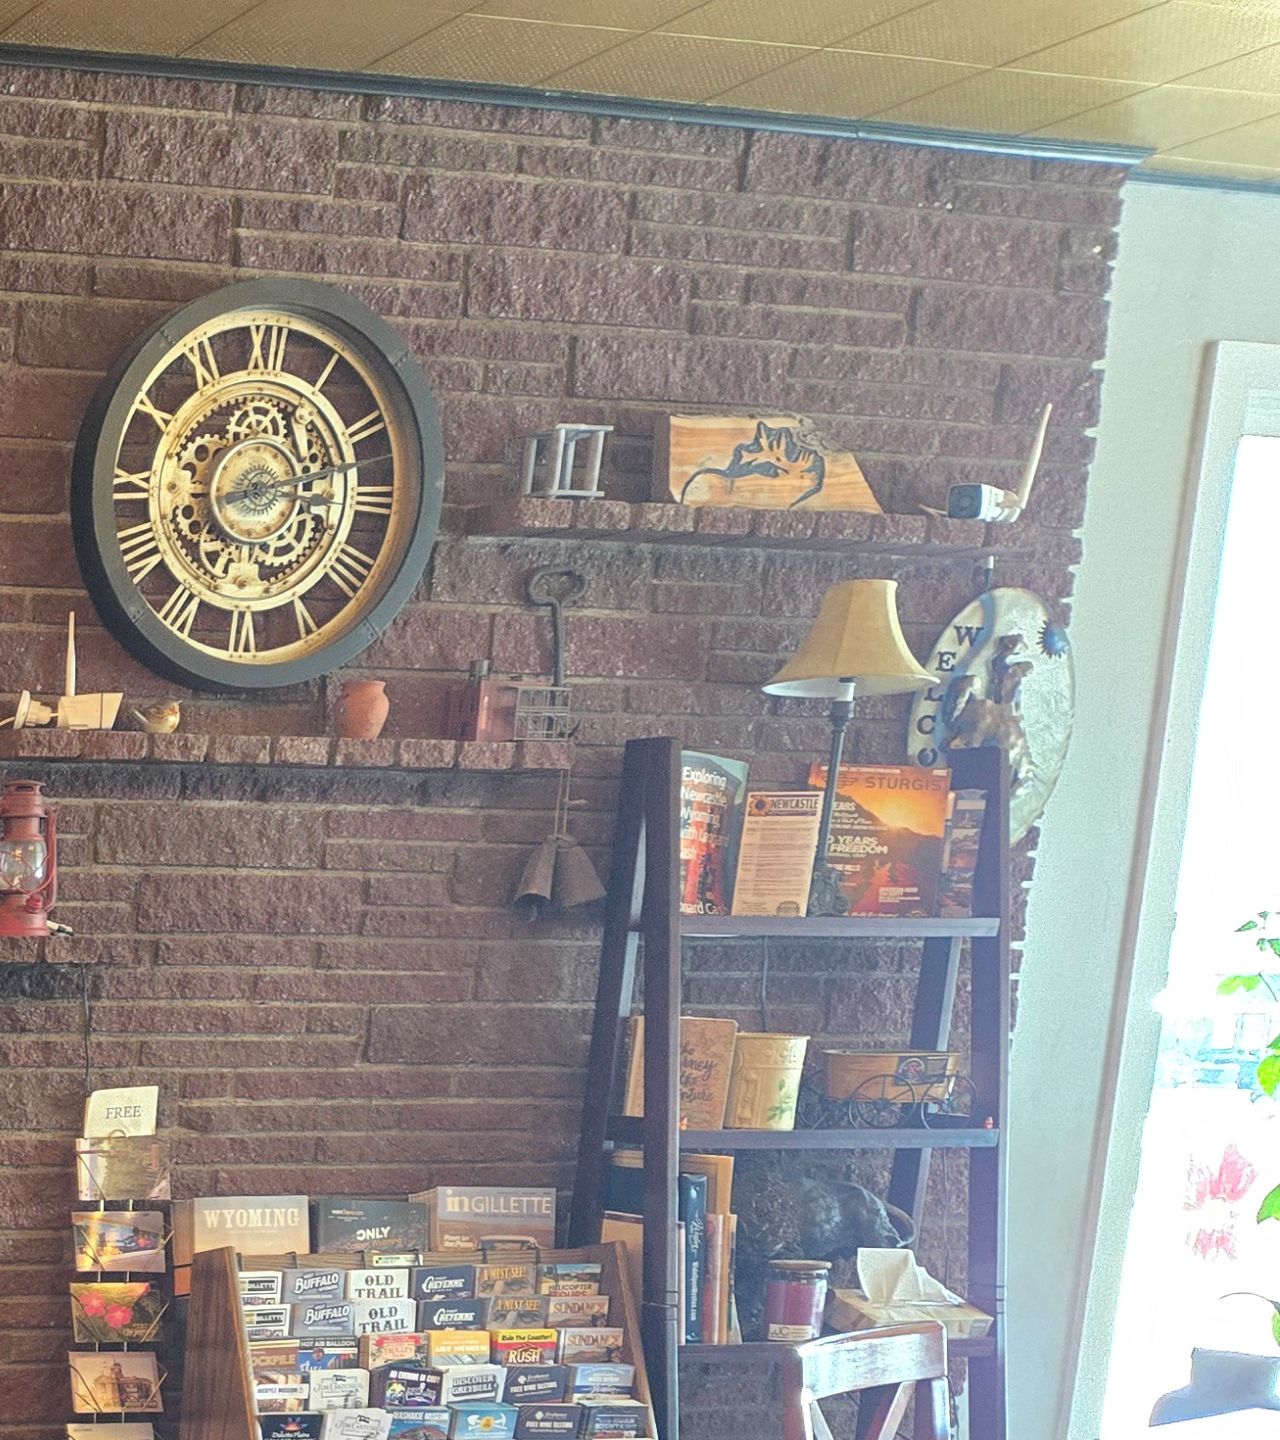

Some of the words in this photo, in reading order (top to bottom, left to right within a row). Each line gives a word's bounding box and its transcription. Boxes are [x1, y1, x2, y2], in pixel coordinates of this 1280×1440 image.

[682, 767, 727, 790] Exploring
[865, 777, 942, 791] STURGIS
[771, 799, 819, 810] NEWCASTLE
[837, 835, 878, 845] YEARS
[105, 1104, 142, 1120] FREE
[203, 1208, 300, 1229] WYOMING
[356, 1226, 391, 1240] ONLY
[293, 1273, 340, 1294] BUFFALO
[364, 1275, 395, 1287] OLD
[549, 1283, 593, 1291] HELICOPTER
[354, 1287, 405, 1299] TRAIL
[368, 1306, 398, 1318] OLD
[552, 1302, 606, 1314] SUNDANCE
[304, 1305, 350, 1325] BUFFALO
[358, 1320, 409, 1333] TRAIL
[528, 1333, 553, 1341] Coaster!
[566, 1334, 621, 1346] SUNDANCE
[251, 1354, 297, 1367] OCKPILE
[508, 1350, 540, 1363] RUSH
[452, 1375, 495, 1386] DISCOVER
[452, 1384, 493, 1395] GREYBULL
